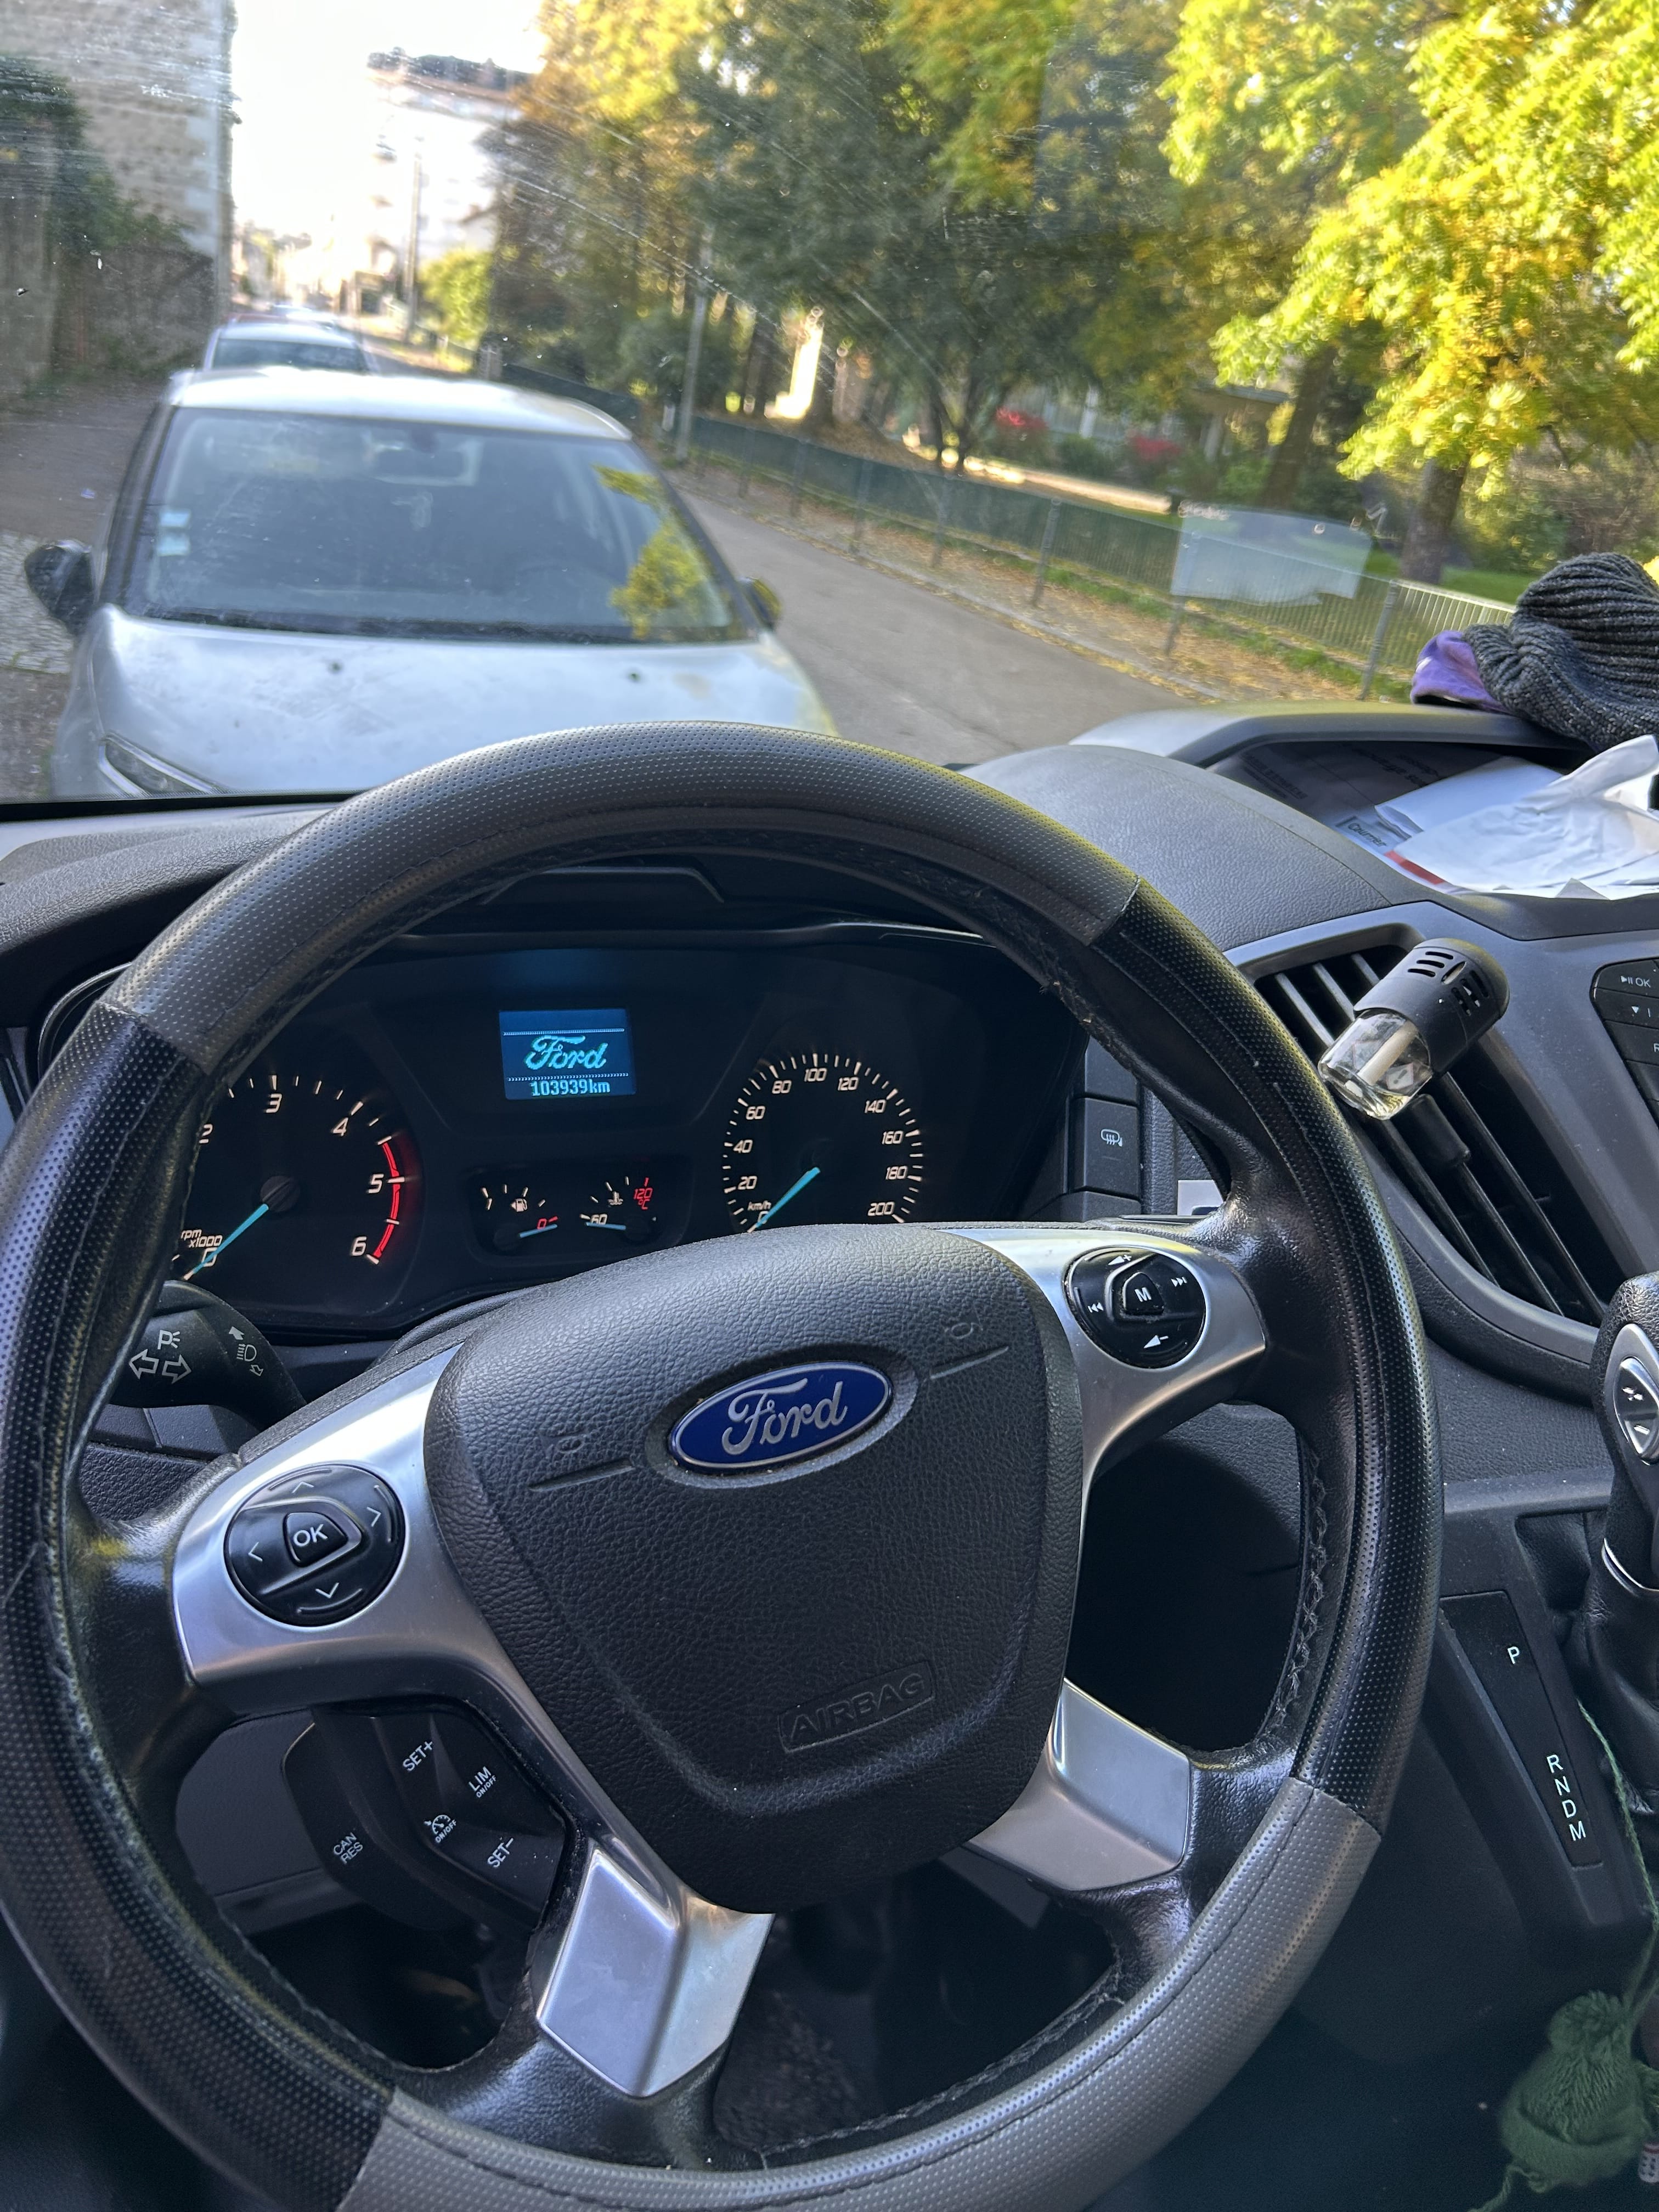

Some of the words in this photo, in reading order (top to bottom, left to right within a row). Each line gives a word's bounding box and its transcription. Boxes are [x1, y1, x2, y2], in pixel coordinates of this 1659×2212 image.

[1635, 977, 1651, 988] OK
[524, 1035, 608, 1070] Ford
[805, 1068, 827, 1082] 100
[838, 1077, 859, 1091] 120
[531, 1079, 610, 1096] 103939km
[772, 1080, 792, 1094] 80
[266, 1093, 282, 1113] 3
[865, 1099, 886, 1113] 140
[746, 1106, 765, 1120] 60
[332, 1118, 348, 1136] 4
[733, 1139, 753, 1153] 40
[882, 1131, 903, 1144] 160
[886, 1166, 907, 1180] 180
[368, 1174, 383, 1193] 5
[738, 1176, 757, 1189] 20
[634, 1188, 652, 1199] 120
[748, 1200, 771, 1211] km/h
[868, 1201, 895, 1216] 200
[537, 1218, 546, 1229] 0
[591, 1214, 607, 1225] 60
[181, 1229, 202, 1240] rpm
[189, 1235, 223, 1248] x1000
[352, 1236, 367, 1256] 6
[202, 1247, 219, 1267] 0
[1135, 1287, 1152, 1302] M
[721, 1378, 849, 1455] Ford
[293, 1524, 328, 1547] OK
[1507, 1646, 1520, 1664] P
[791, 1673, 924, 1741] AIRBAG
[403, 1741, 433, 1771] SET+
[1547, 1754, 1564, 1773] R
[469, 1766, 492, 1792] LIM
[476, 1775, 496, 1797] ON/OFF
[1555, 1776, 1571, 1796] N
[1562, 1799, 1577, 1818] D
[435, 1819, 457, 1843] ON/OFF
[1569, 1821, 1586, 1841] M
[334, 1832, 357, 1855] CAN
[341, 1842, 363, 1864] RES
